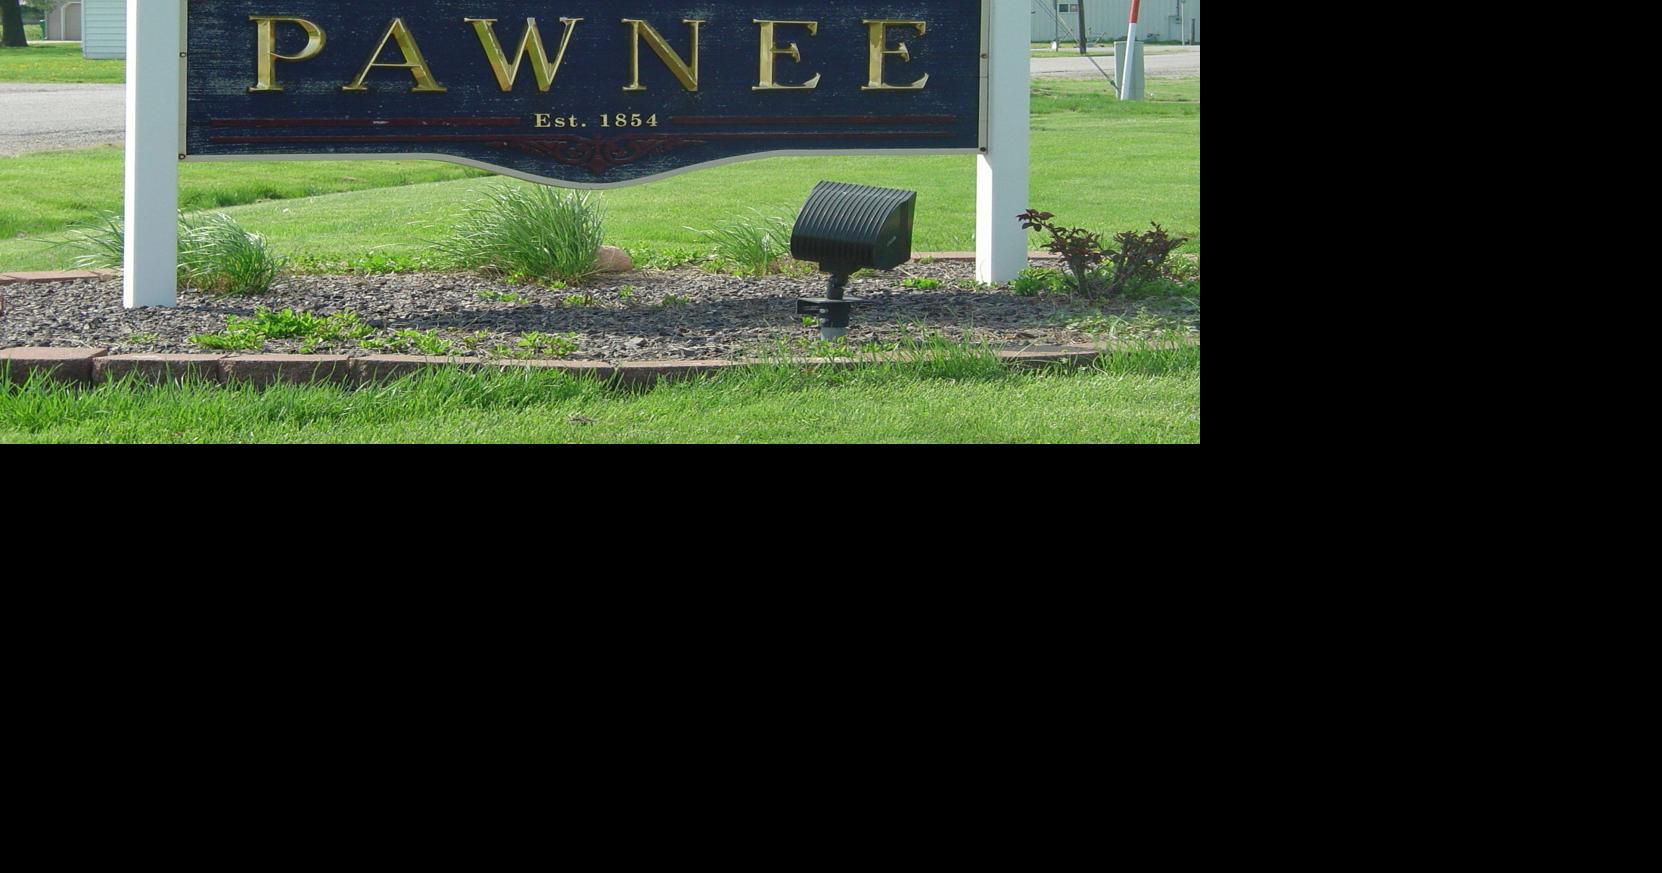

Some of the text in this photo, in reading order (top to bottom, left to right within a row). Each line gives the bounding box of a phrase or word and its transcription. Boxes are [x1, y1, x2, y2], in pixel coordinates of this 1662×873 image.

[248, 16, 930, 92] PAWNEE
[534, 113, 658, 128] Est. 1854
